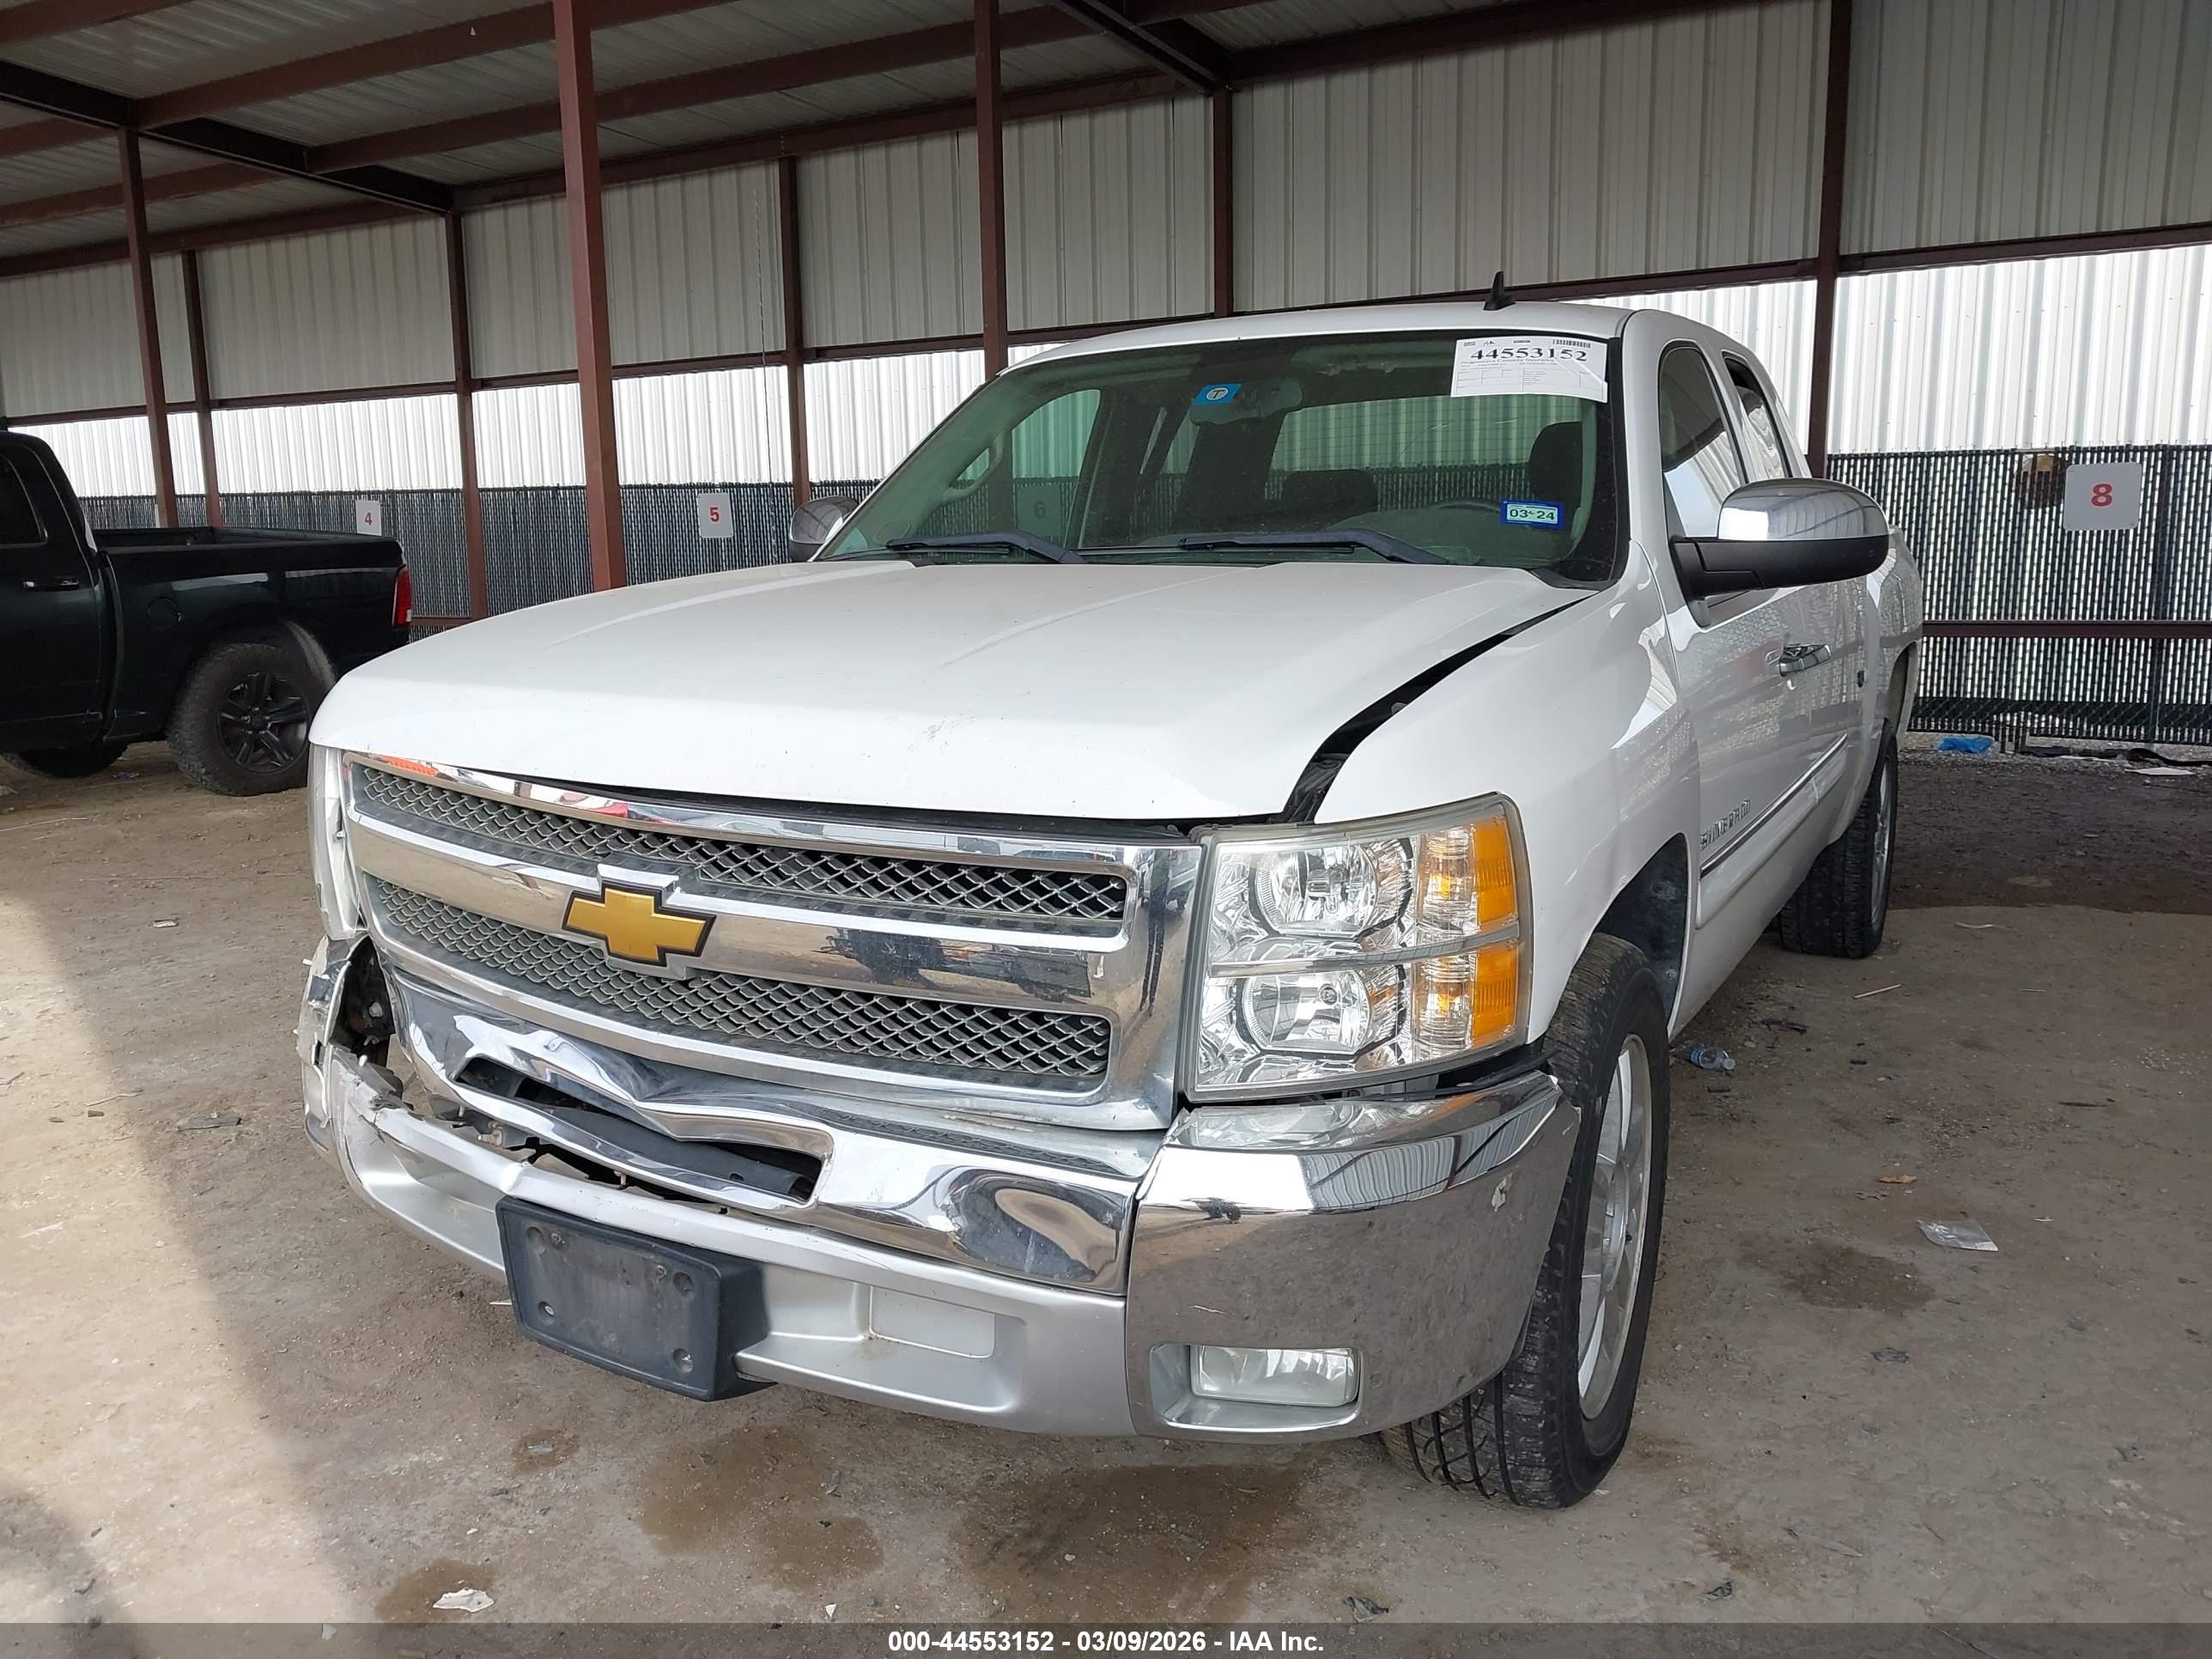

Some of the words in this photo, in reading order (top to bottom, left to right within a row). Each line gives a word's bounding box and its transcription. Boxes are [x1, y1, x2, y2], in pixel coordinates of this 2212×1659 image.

[1470, 347, 1588, 362] 44553152
[2091, 483, 2113, 507] 8
[709, 507, 720, 522] 5
[1034, 501, 1046, 519] 6
[1510, 508, 1528, 519] 03
[1536, 511, 1555, 520] 24
[364, 512, 373, 526] 4
